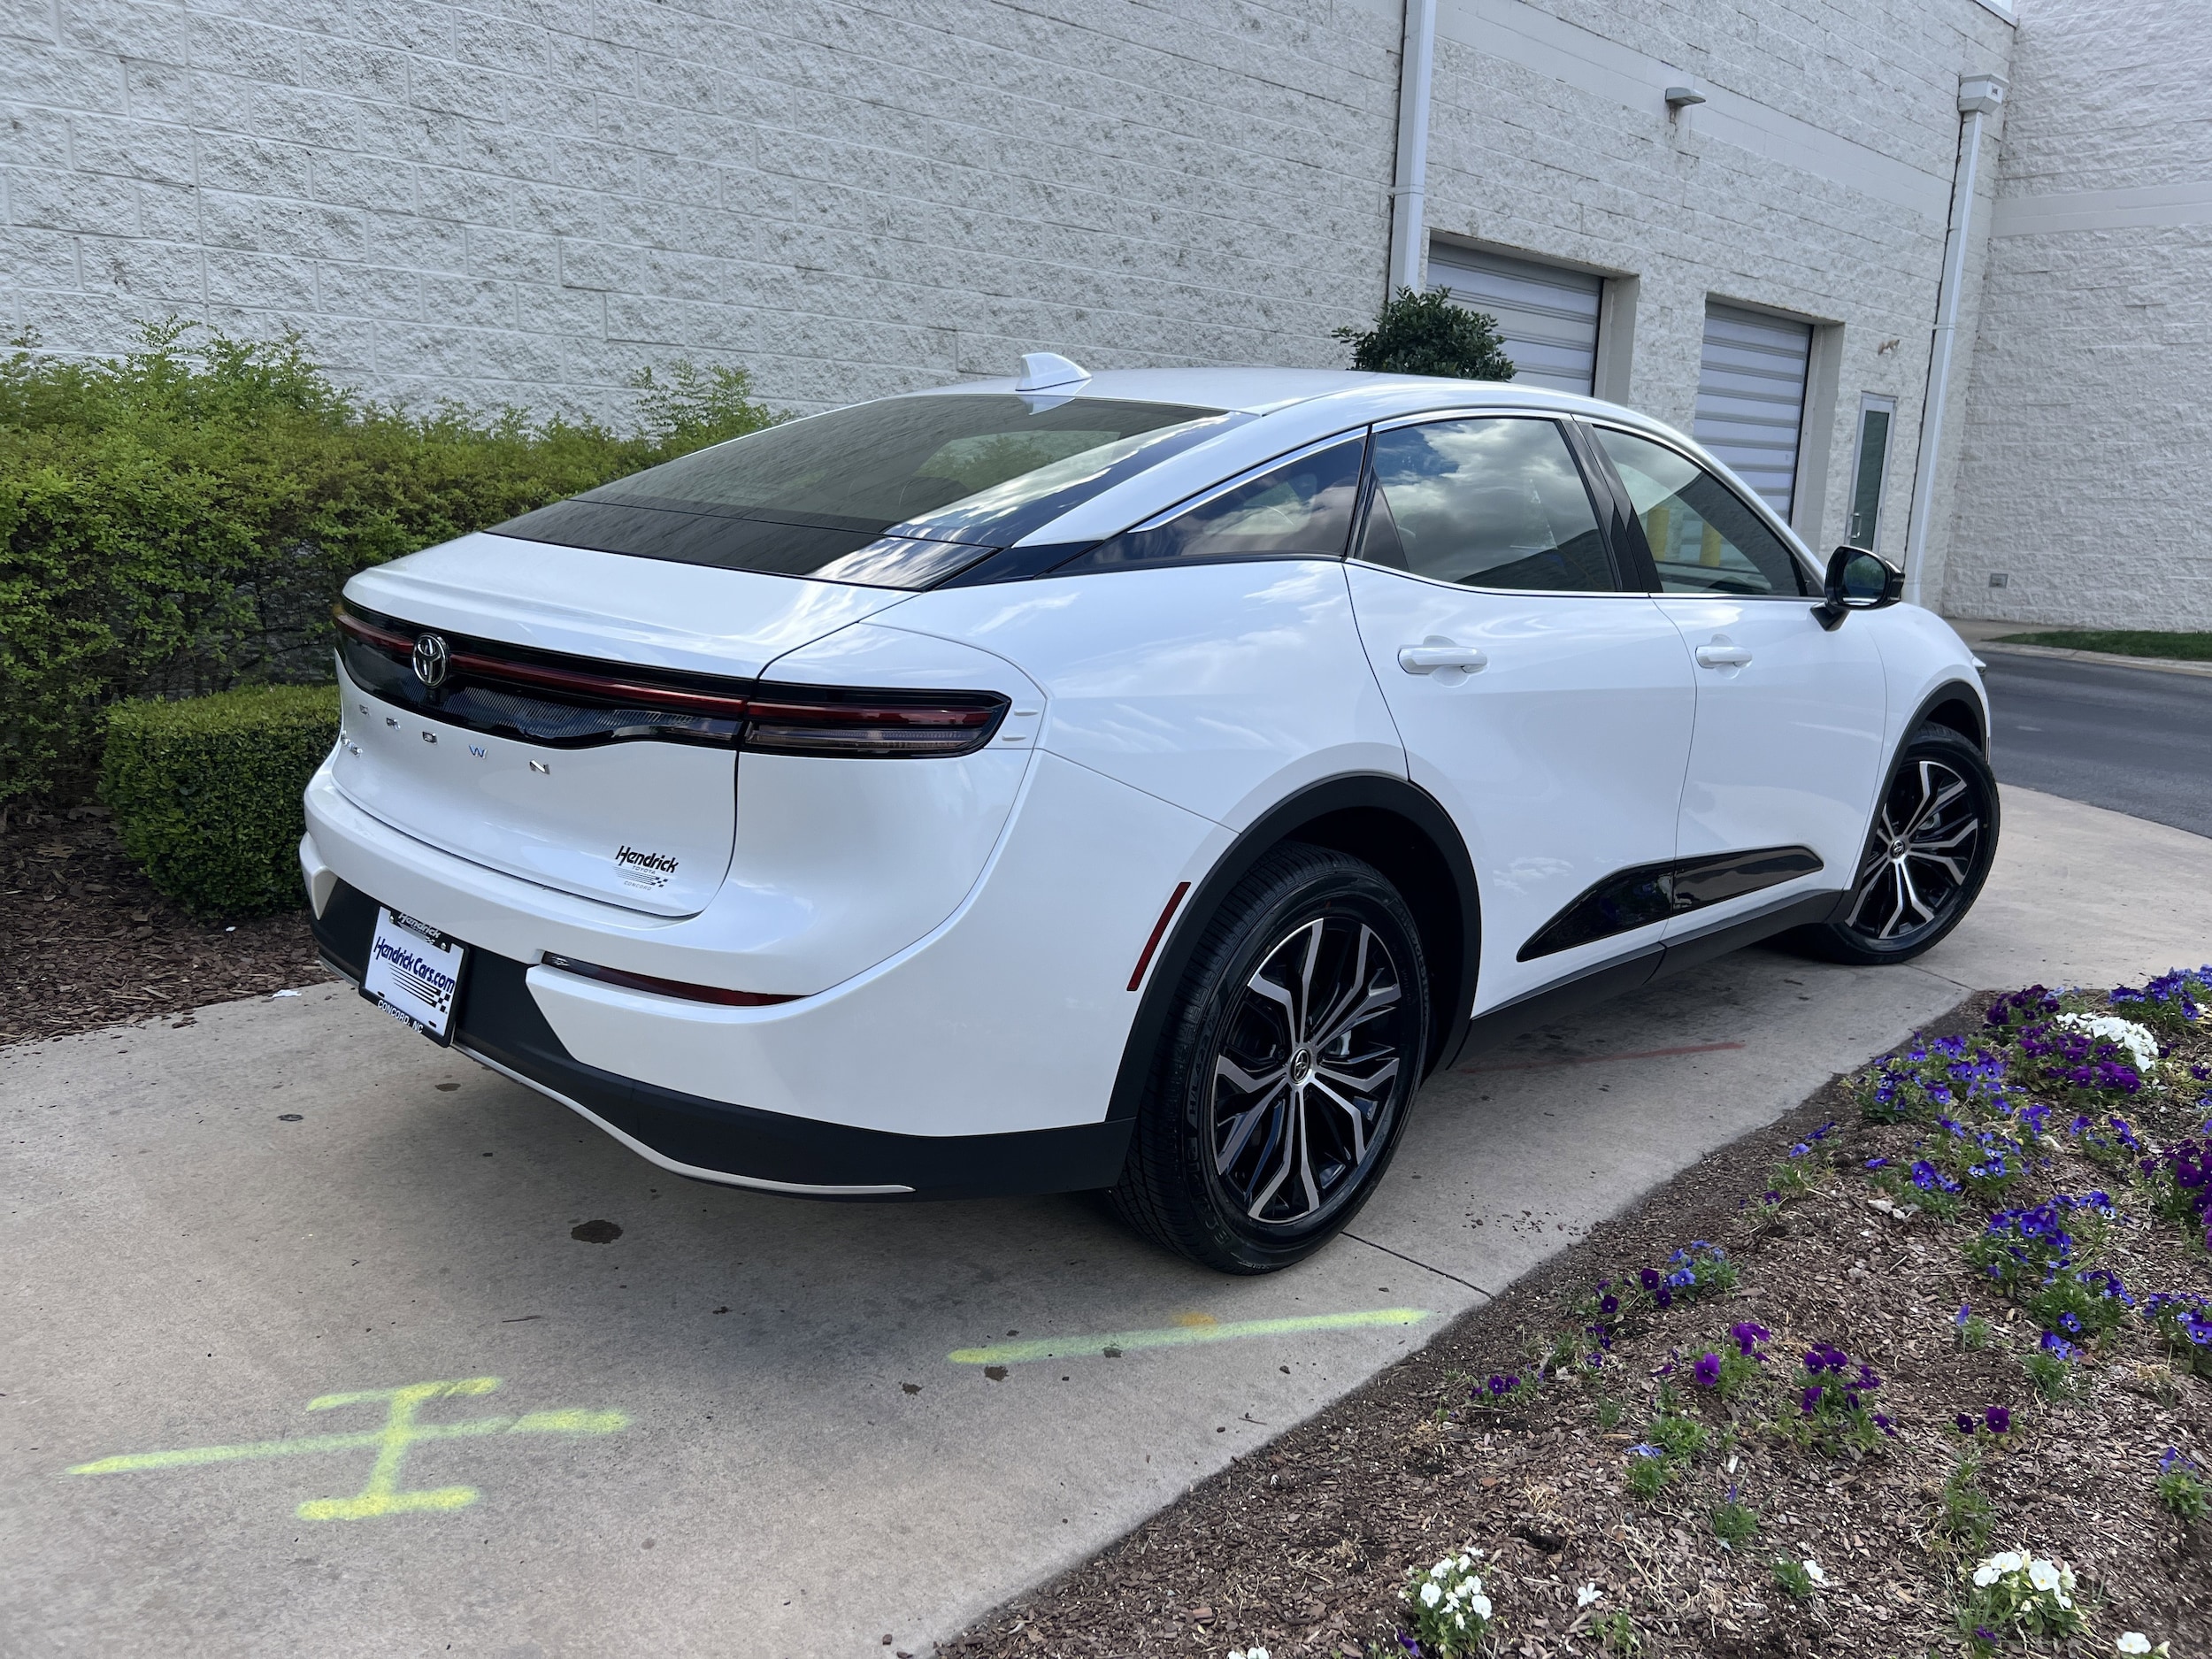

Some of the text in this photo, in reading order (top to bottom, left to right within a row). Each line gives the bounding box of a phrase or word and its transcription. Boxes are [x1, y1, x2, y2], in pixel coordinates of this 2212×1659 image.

[615, 845, 679, 873] Hendrick
[632, 865, 656, 874] TOYOTA
[624, 880, 652, 891] CONCORD
[398, 912, 442, 939] Hendrick
[373, 936, 456, 994] HendrickCars.com
[377, 1000, 424, 1033] CONCORD, NC
